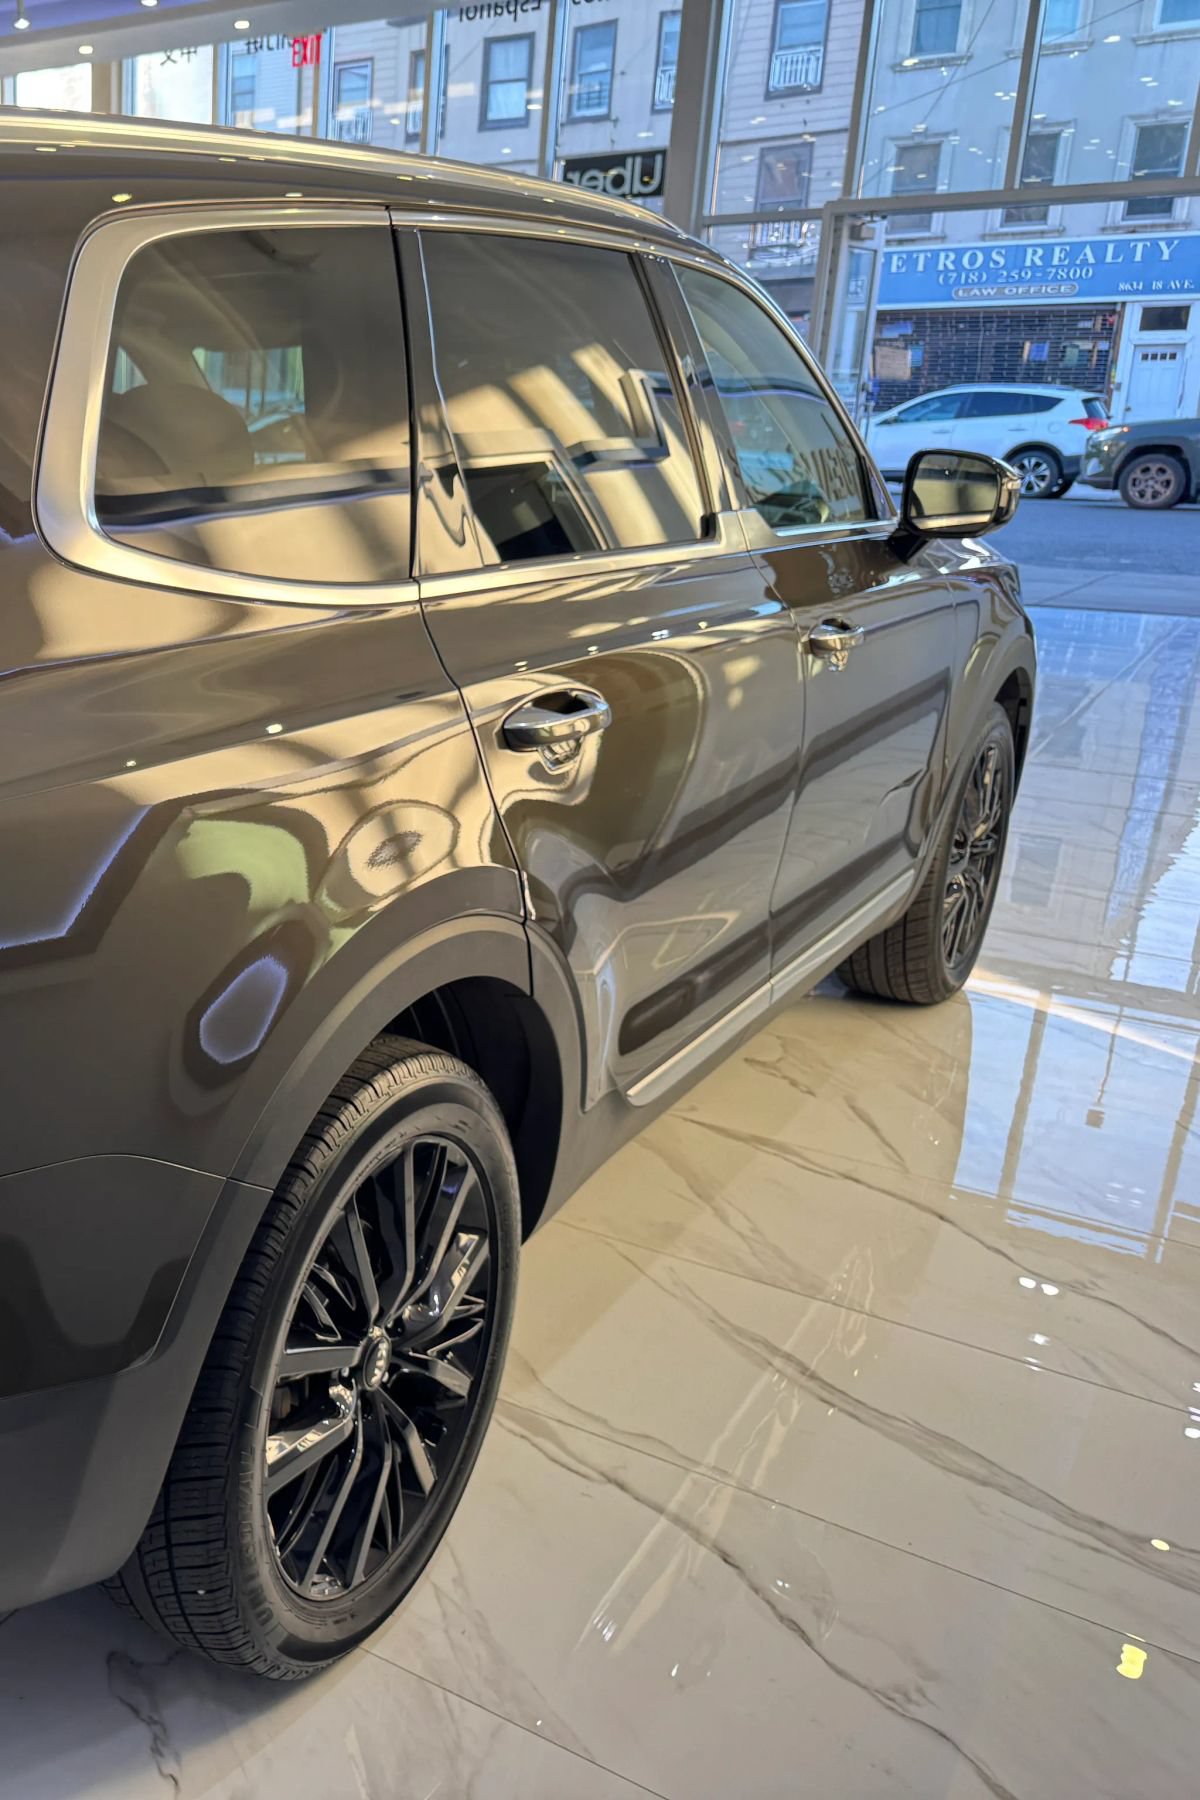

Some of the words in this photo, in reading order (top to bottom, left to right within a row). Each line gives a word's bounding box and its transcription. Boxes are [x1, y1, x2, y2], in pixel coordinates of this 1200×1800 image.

[291, 34, 322, 67] EXIT
[884, 248, 1006, 274] ETROS
[1024, 239, 1180, 267] REALTY
[938, 270, 987, 286] (718)
[958, 286, 997, 298] LAW
[1004, 284, 1075, 296] OFFICE
